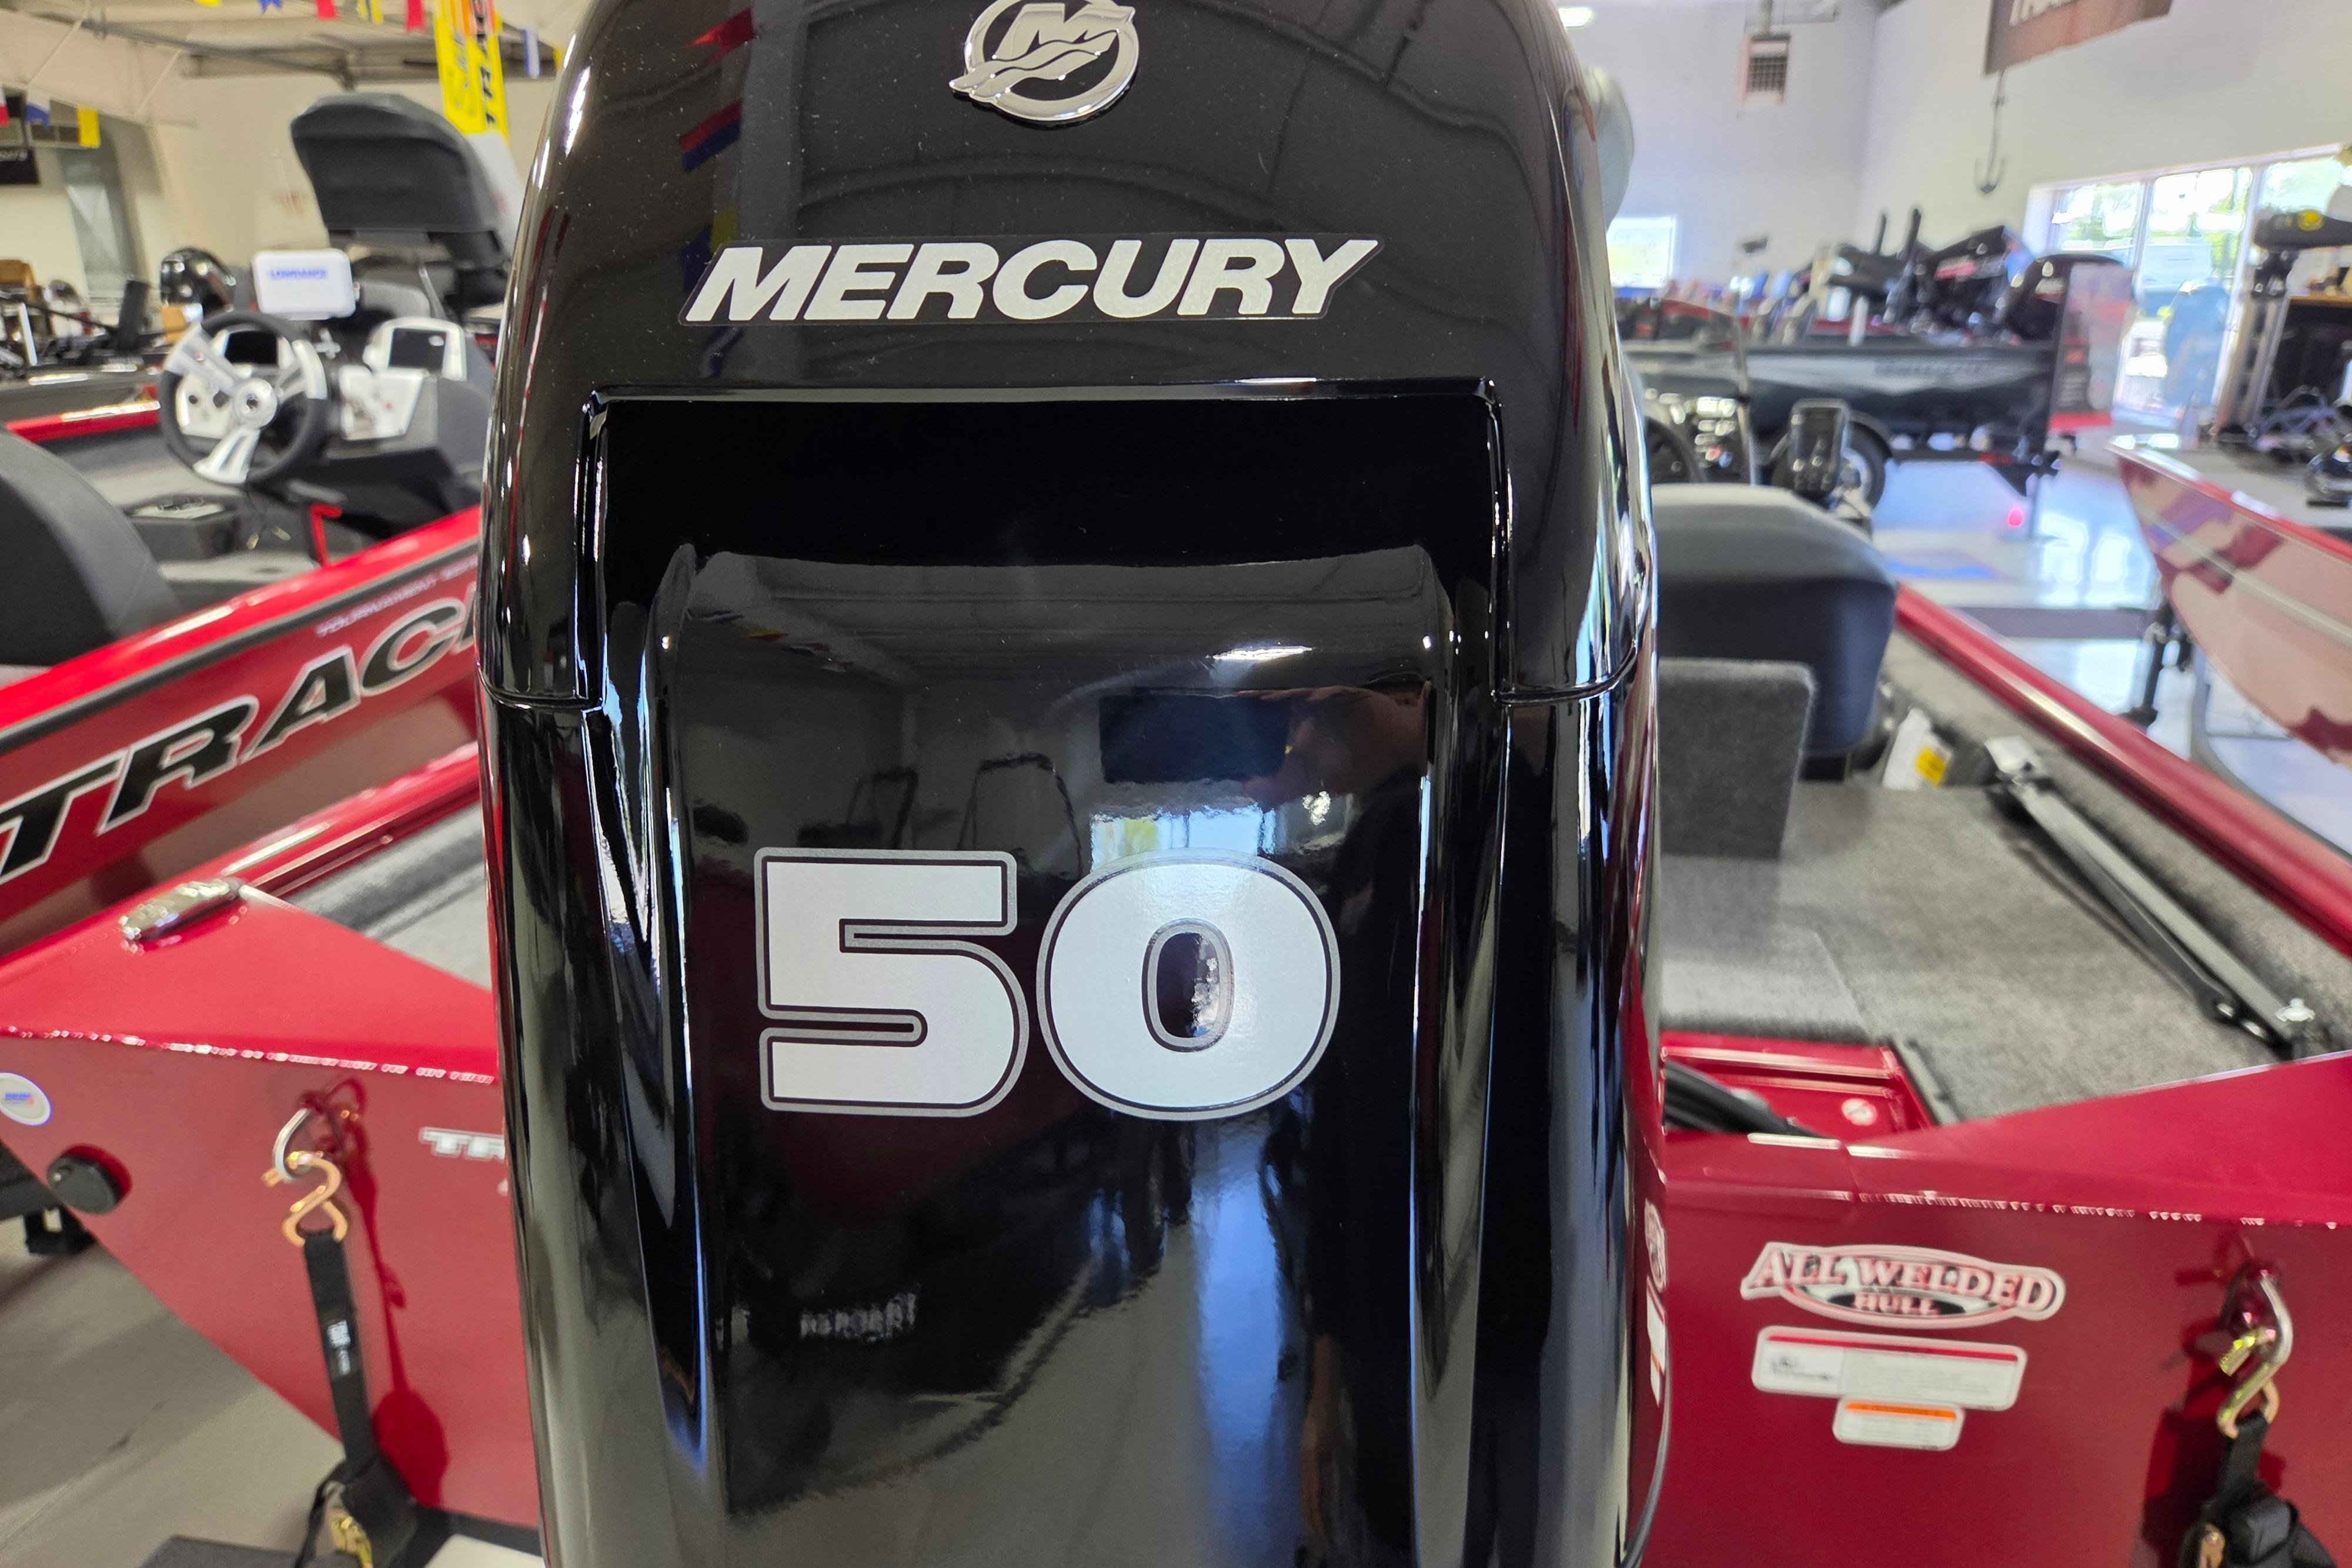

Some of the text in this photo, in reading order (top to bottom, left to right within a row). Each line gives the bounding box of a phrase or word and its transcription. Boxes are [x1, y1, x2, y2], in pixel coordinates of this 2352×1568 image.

[686, 239, 1378, 321] MERCURY
[0, 581, 478, 885] TRAC
[754, 847, 1341, 1121] 50
[1746, 1248, 2054, 1313] ALL WELDED
[1852, 1292, 1941, 1317] HULL
